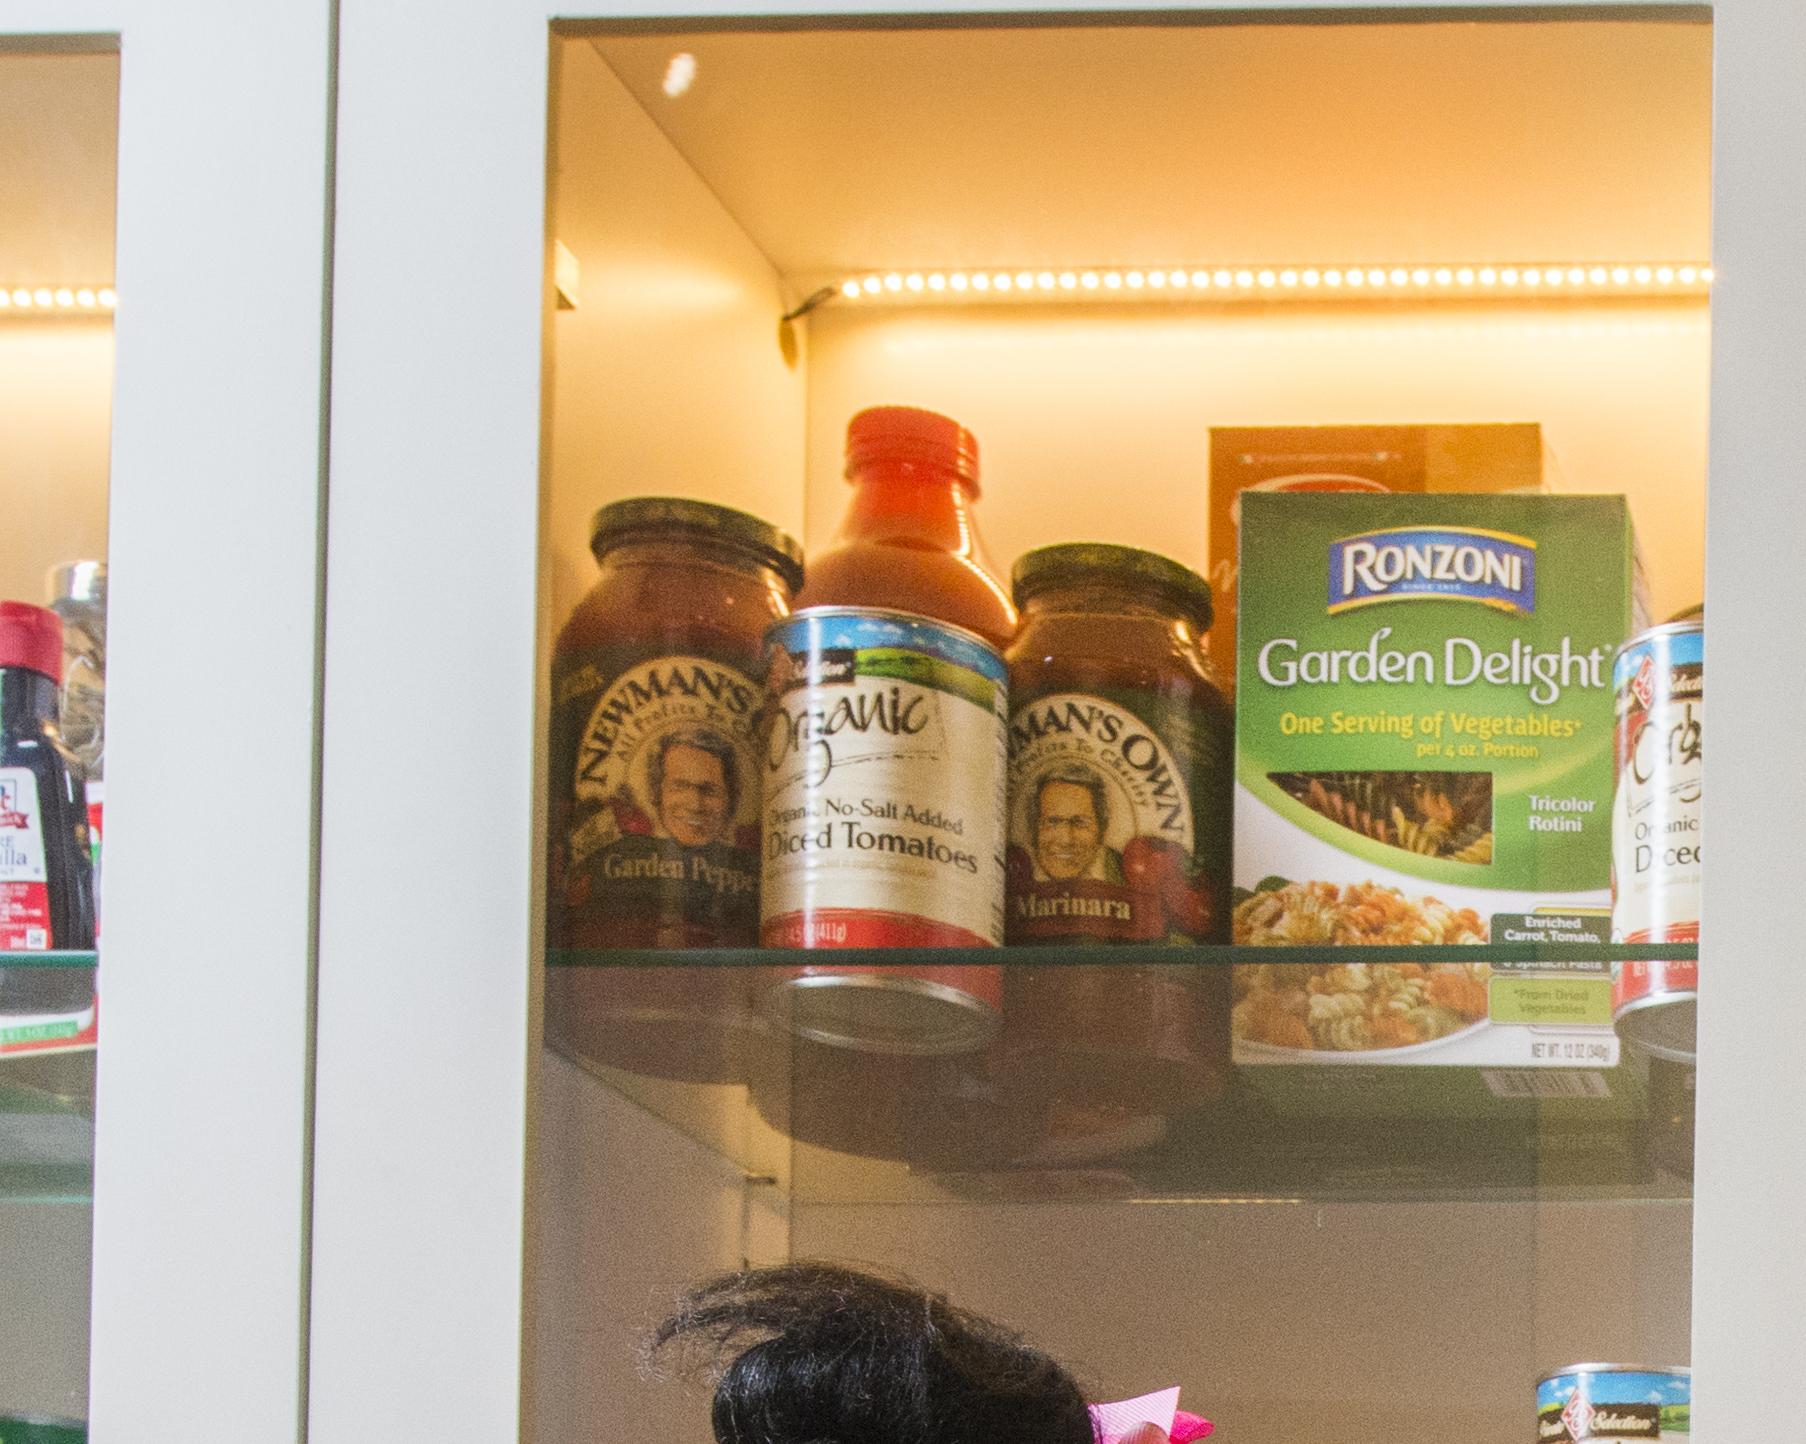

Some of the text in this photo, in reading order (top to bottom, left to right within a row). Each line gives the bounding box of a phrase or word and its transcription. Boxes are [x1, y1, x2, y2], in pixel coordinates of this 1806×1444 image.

[1341, 541, 1522, 595] RONZONI
[1257, 627, 1605, 705] Garden Delight
[579, 664, 752, 788] NEWMAN'S
[1279, 710, 1324, 736] One
[1330, 709, 1415, 740] Serving
[1419, 710, 1444, 738] of
[1415, 742, 1442, 759] per
[1482, 741, 1540, 759] Portion
[824, 797, 964, 837] No-Salt Added
[1528, 793, 1597, 813] Tricolor
[1528, 815, 1584, 834] Rotini
[839, 822, 978, 874] Tomatoes
[603, 852, 759, 894] Garden Peppe
[1016, 891, 1132, 921] Marinara
[1524, 915, 1582, 930] Enriched
[1531, 1042, 1548, 1059] NET
[1589, 1411, 1652, 1431] Selection
